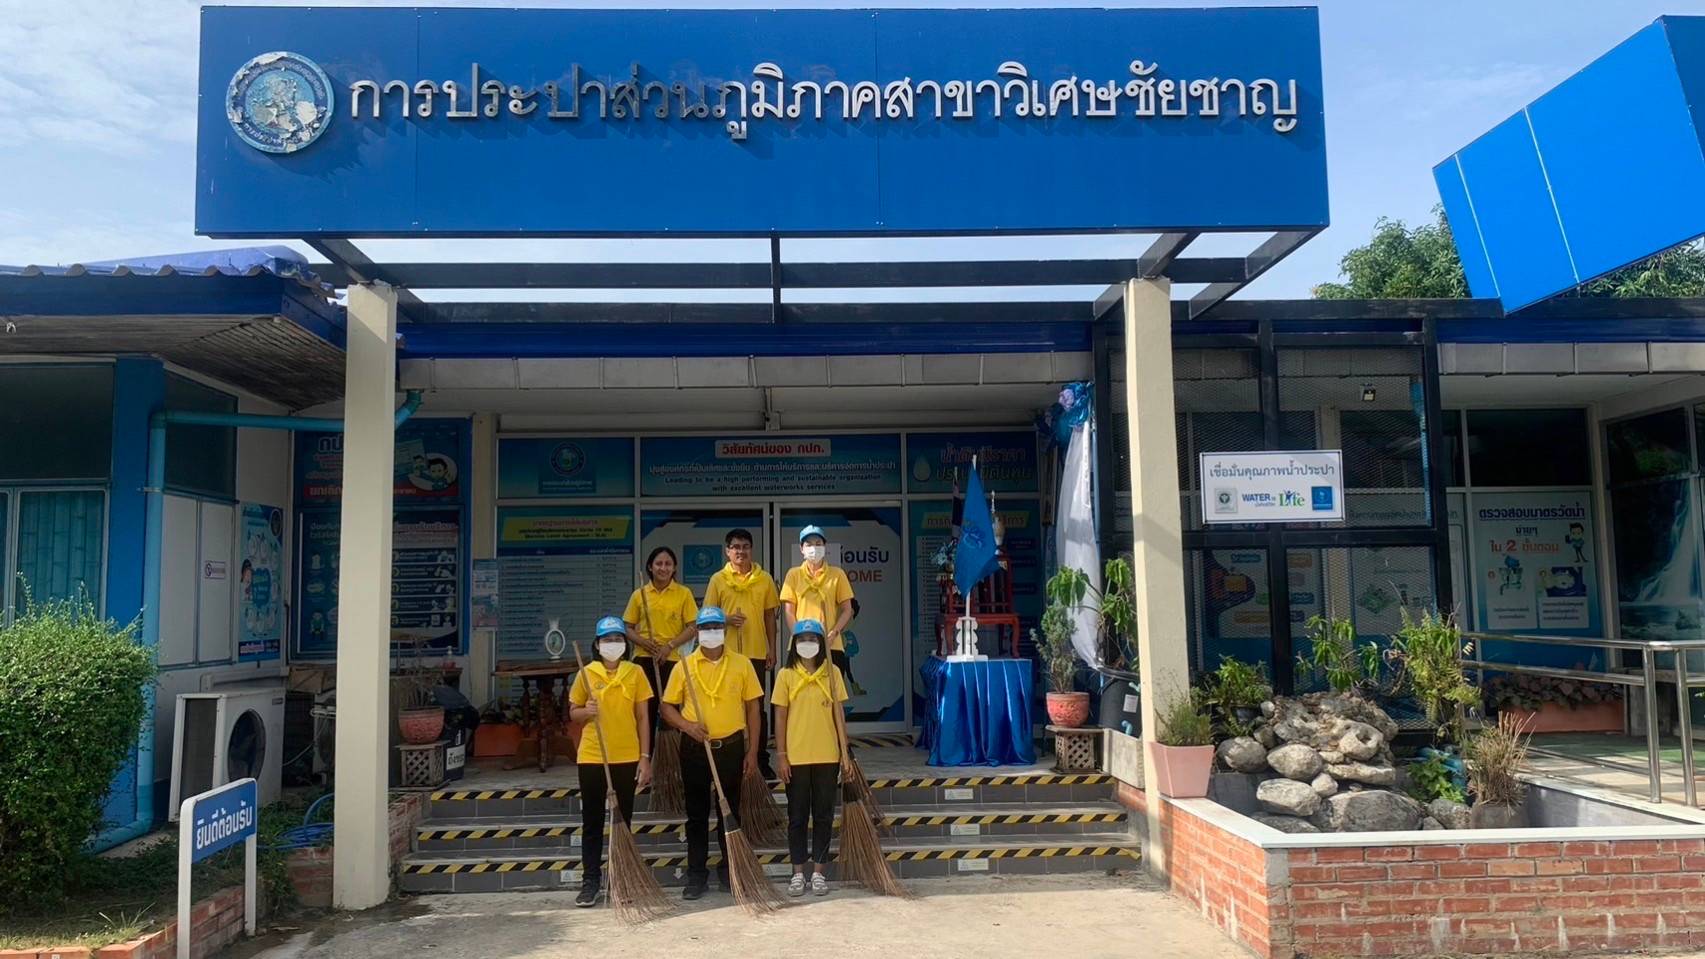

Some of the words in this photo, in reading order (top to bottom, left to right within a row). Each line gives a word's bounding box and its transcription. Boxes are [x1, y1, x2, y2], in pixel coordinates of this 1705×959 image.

[349, 59, 1298, 141] การประปาส่วนภูมิภาคสาขาวิเศษชัยชาญ
[1209, 459, 1335, 480] เชื่อมั่นคุณภาพน้ำประปา
[664, 476, 693, 485] Leading
[723, 475, 738, 484] high
[741, 474, 779, 484] performing
[1242, 493, 1271, 502] WATER
[1479, 501, 1585, 519] ตรวจสอบมาตรวัดน้ำ
[1489, 539, 1502, 553] ใน
[1506, 539, 1518, 552] 2
[1522, 537, 1560, 553] ขั้นตอน
[196, 799, 253, 850] ยินดีต้อนรับ
